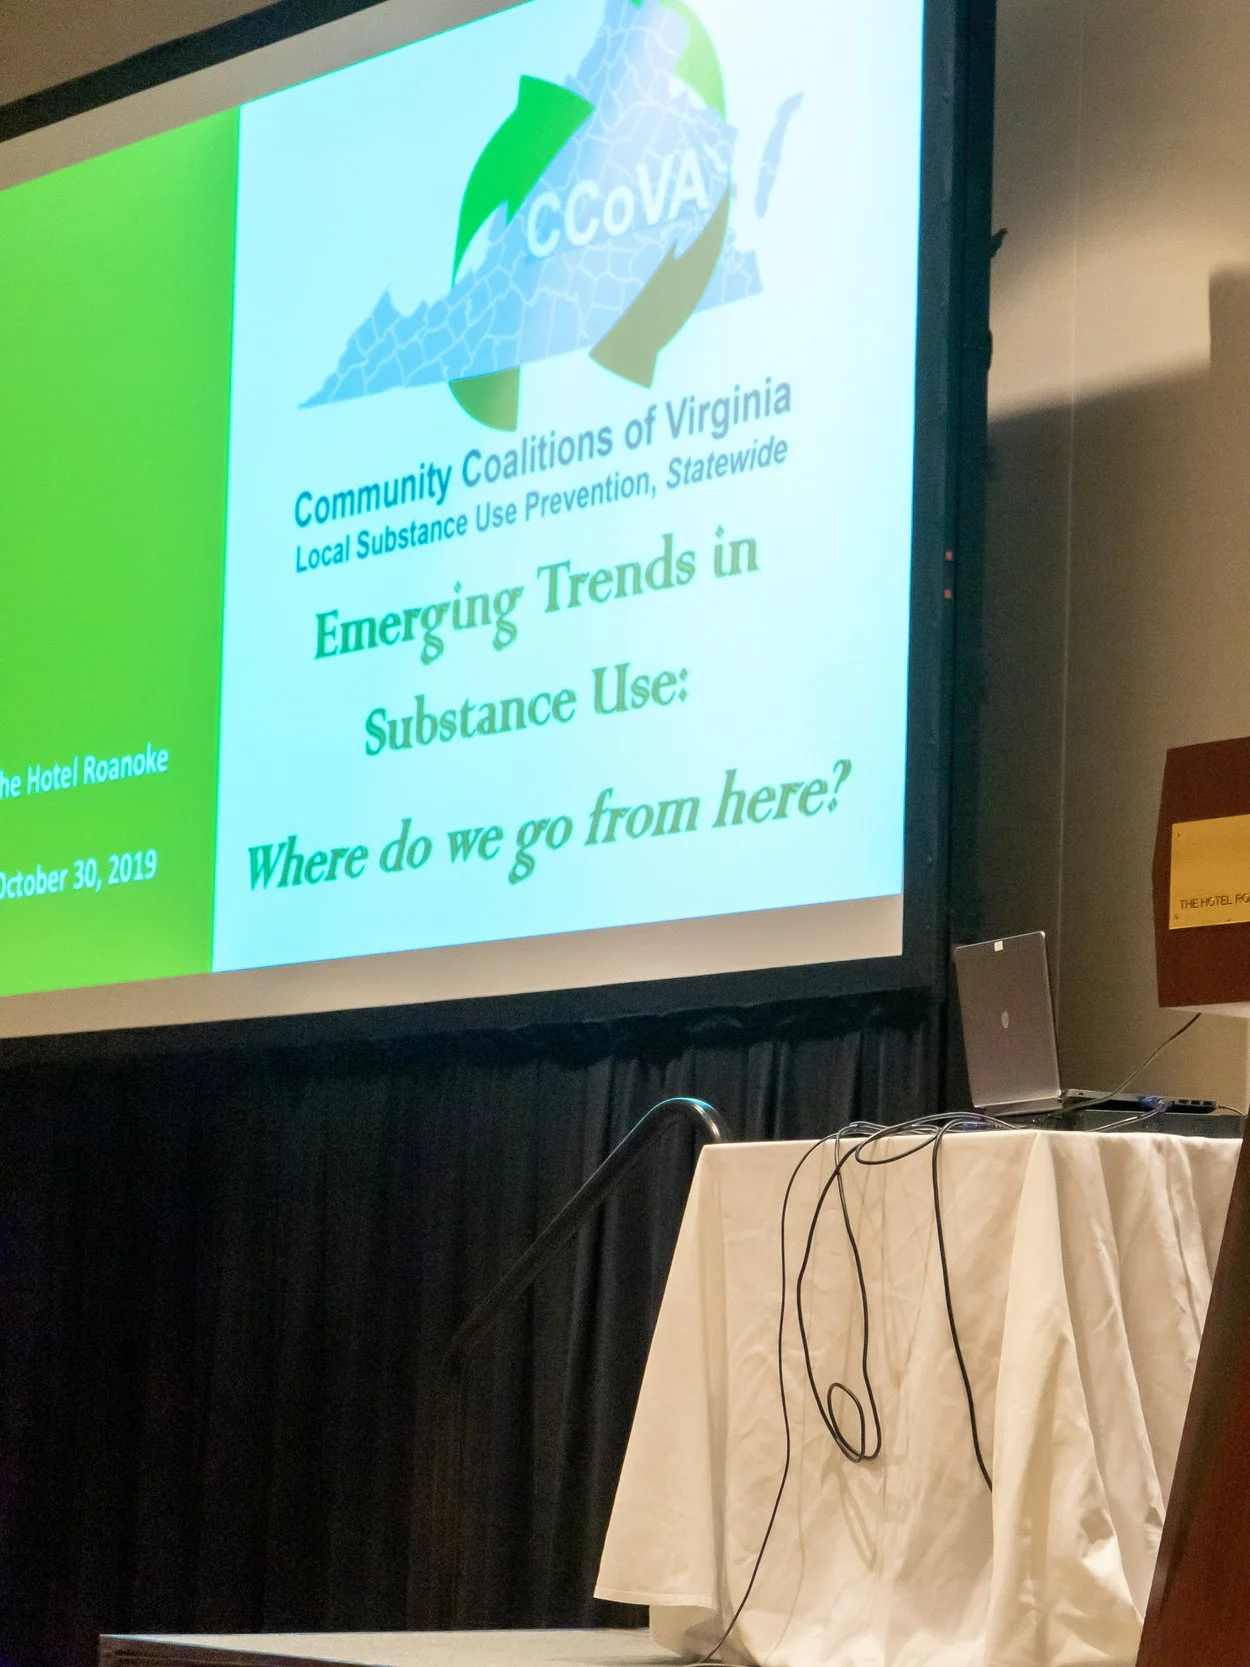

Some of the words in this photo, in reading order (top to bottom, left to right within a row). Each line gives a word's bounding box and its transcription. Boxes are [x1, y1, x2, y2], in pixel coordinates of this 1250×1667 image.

[526, 149, 708, 258] CCoVA
[295, 460, 452, 528] Community
[462, 430, 613, 487] Coalitions
[624, 404, 657, 446] of
[666, 376, 792, 439] Virginia
[296, 535, 350, 573] Local
[357, 513, 467, 559] Substance
[475, 499, 517, 533] Use
[525, 469, 656, 522] Prevention,
[666, 435, 788, 490] Statewide
[314, 581, 524, 666] Emerging
[536, 533, 696, 615] Trends
[713, 524, 760, 579] in
[365, 687, 576, 757] Substance
[591, 662, 689, 714] Use:
[0, 769, 21, 799] he
[27, 756, 78, 795] Hotel
[83, 741, 169, 785] Roanoke
[247, 835, 369, 891] Where
[379, 818, 432, 874] do
[447, 823, 504, 862] we
[508, 813, 573, 886] go
[584, 788, 700, 847] from
[712, 758, 852, 829] here?
[73, 857, 102, 893] 30,
[108, 849, 157, 885] 2019
[1180, 898, 1198, 909] THE
[1201, 895, 1232, 907] HOTEL
